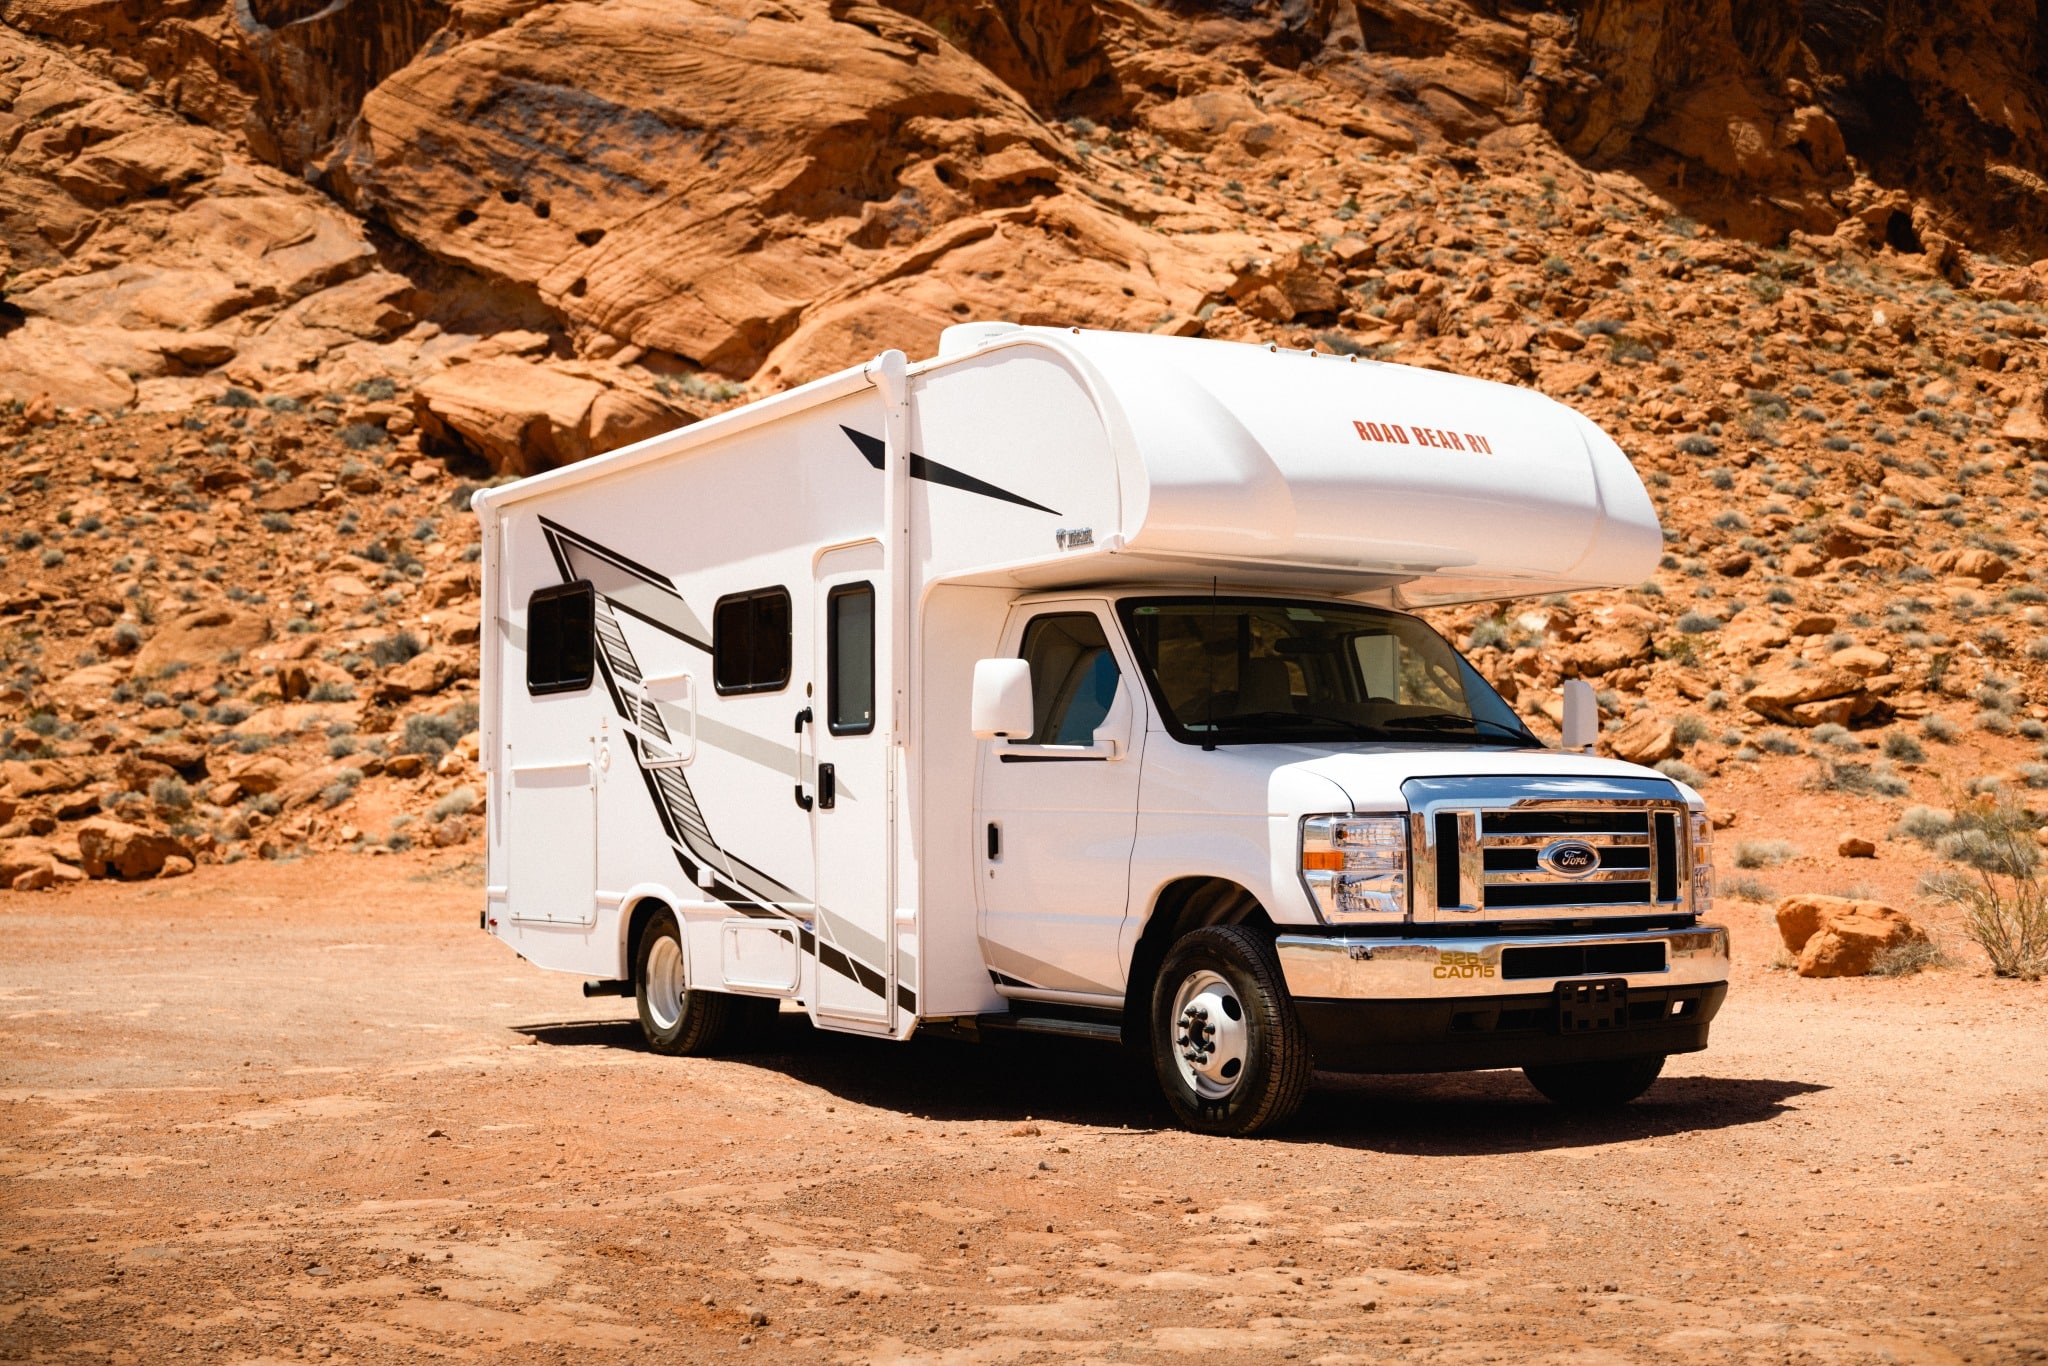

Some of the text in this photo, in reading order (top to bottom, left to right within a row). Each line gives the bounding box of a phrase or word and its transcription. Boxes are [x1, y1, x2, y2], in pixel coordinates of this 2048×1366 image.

[1352, 420, 1493, 455] ROAD BEAR RV
[1561, 850, 1588, 865] Ford
